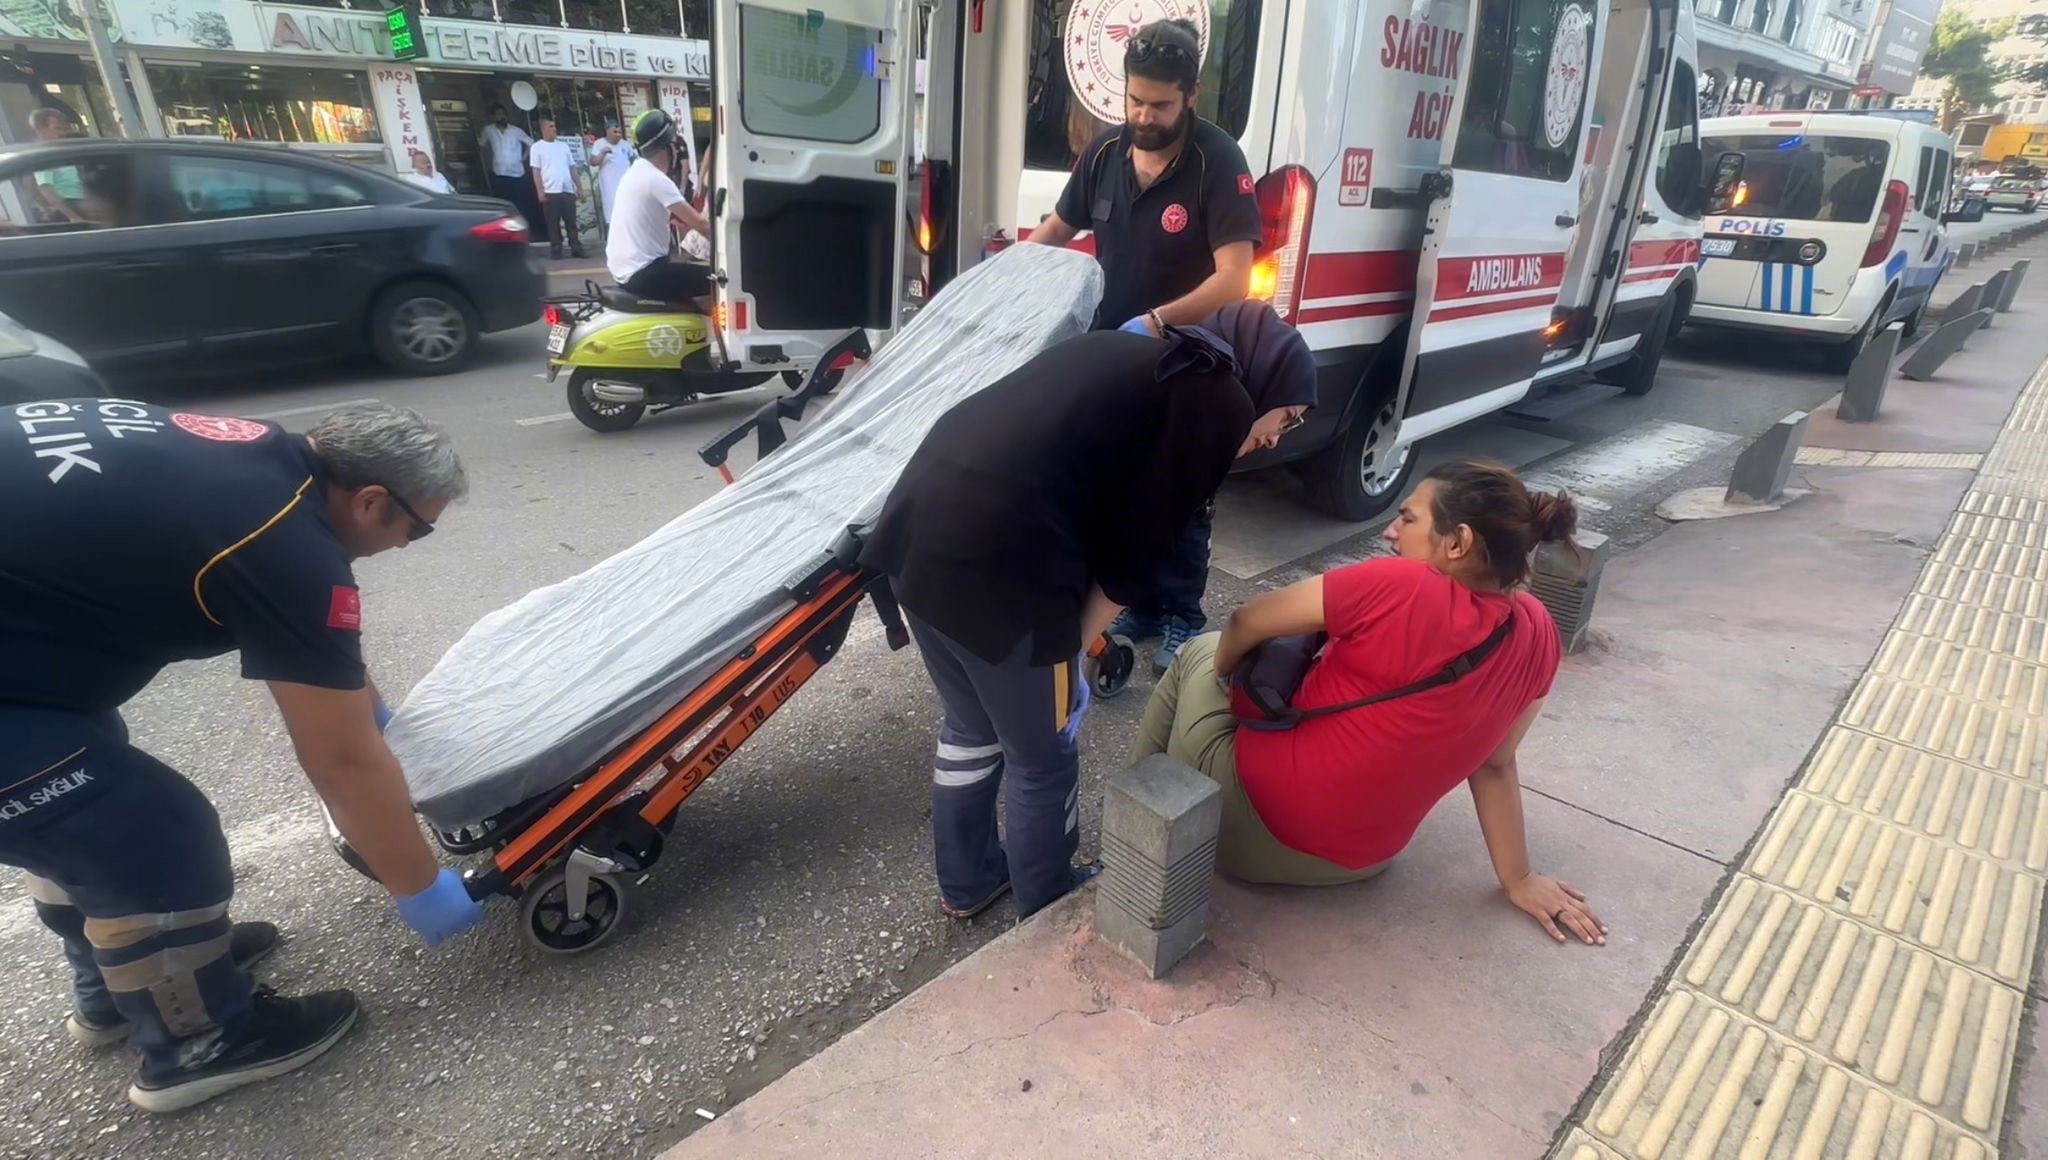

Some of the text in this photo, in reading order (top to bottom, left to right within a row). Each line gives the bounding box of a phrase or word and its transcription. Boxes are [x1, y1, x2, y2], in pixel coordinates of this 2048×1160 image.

[1381, 13, 1464, 80] SAĞLIK
[1347, 155, 1367, 182] 112
[1720, 218, 1785, 236] POLİS
[1466, 256, 1542, 293] AMBULANS
[702, 737, 731, 767] TAY
[29, 768, 94, 805] SAĞLIK
